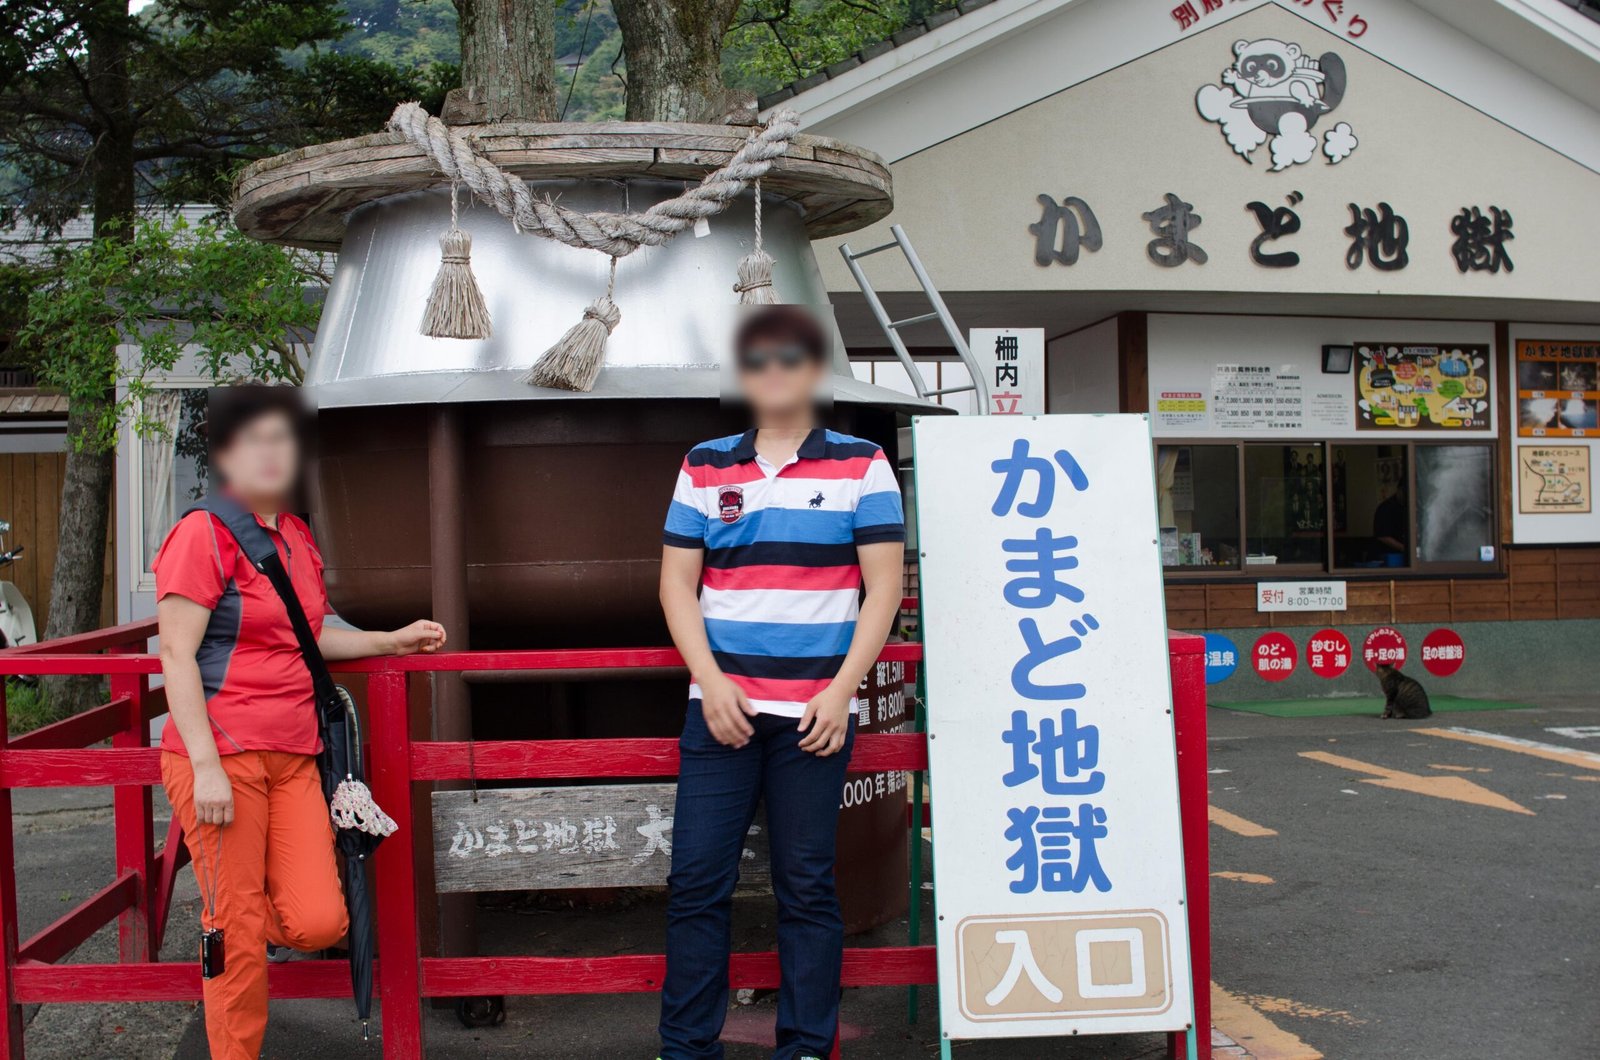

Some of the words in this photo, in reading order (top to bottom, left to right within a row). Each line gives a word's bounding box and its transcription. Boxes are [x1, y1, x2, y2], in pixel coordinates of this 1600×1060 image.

[1028, 190, 1515, 274] かまど地獄
[1261, 589, 1284, 604] 受付
[1299, 586, 1332, 595] 営業時間
[1311, 639, 1346, 653] 砂むし
[991, 438, 1112, 894] かまど地獄
[1203, 650, 1236, 667] 温泉
[1258, 657, 1293, 671] 肌の湯
[449, 815, 621, 858] かまど地獄
[985, 927, 1145, 1006] 入口
